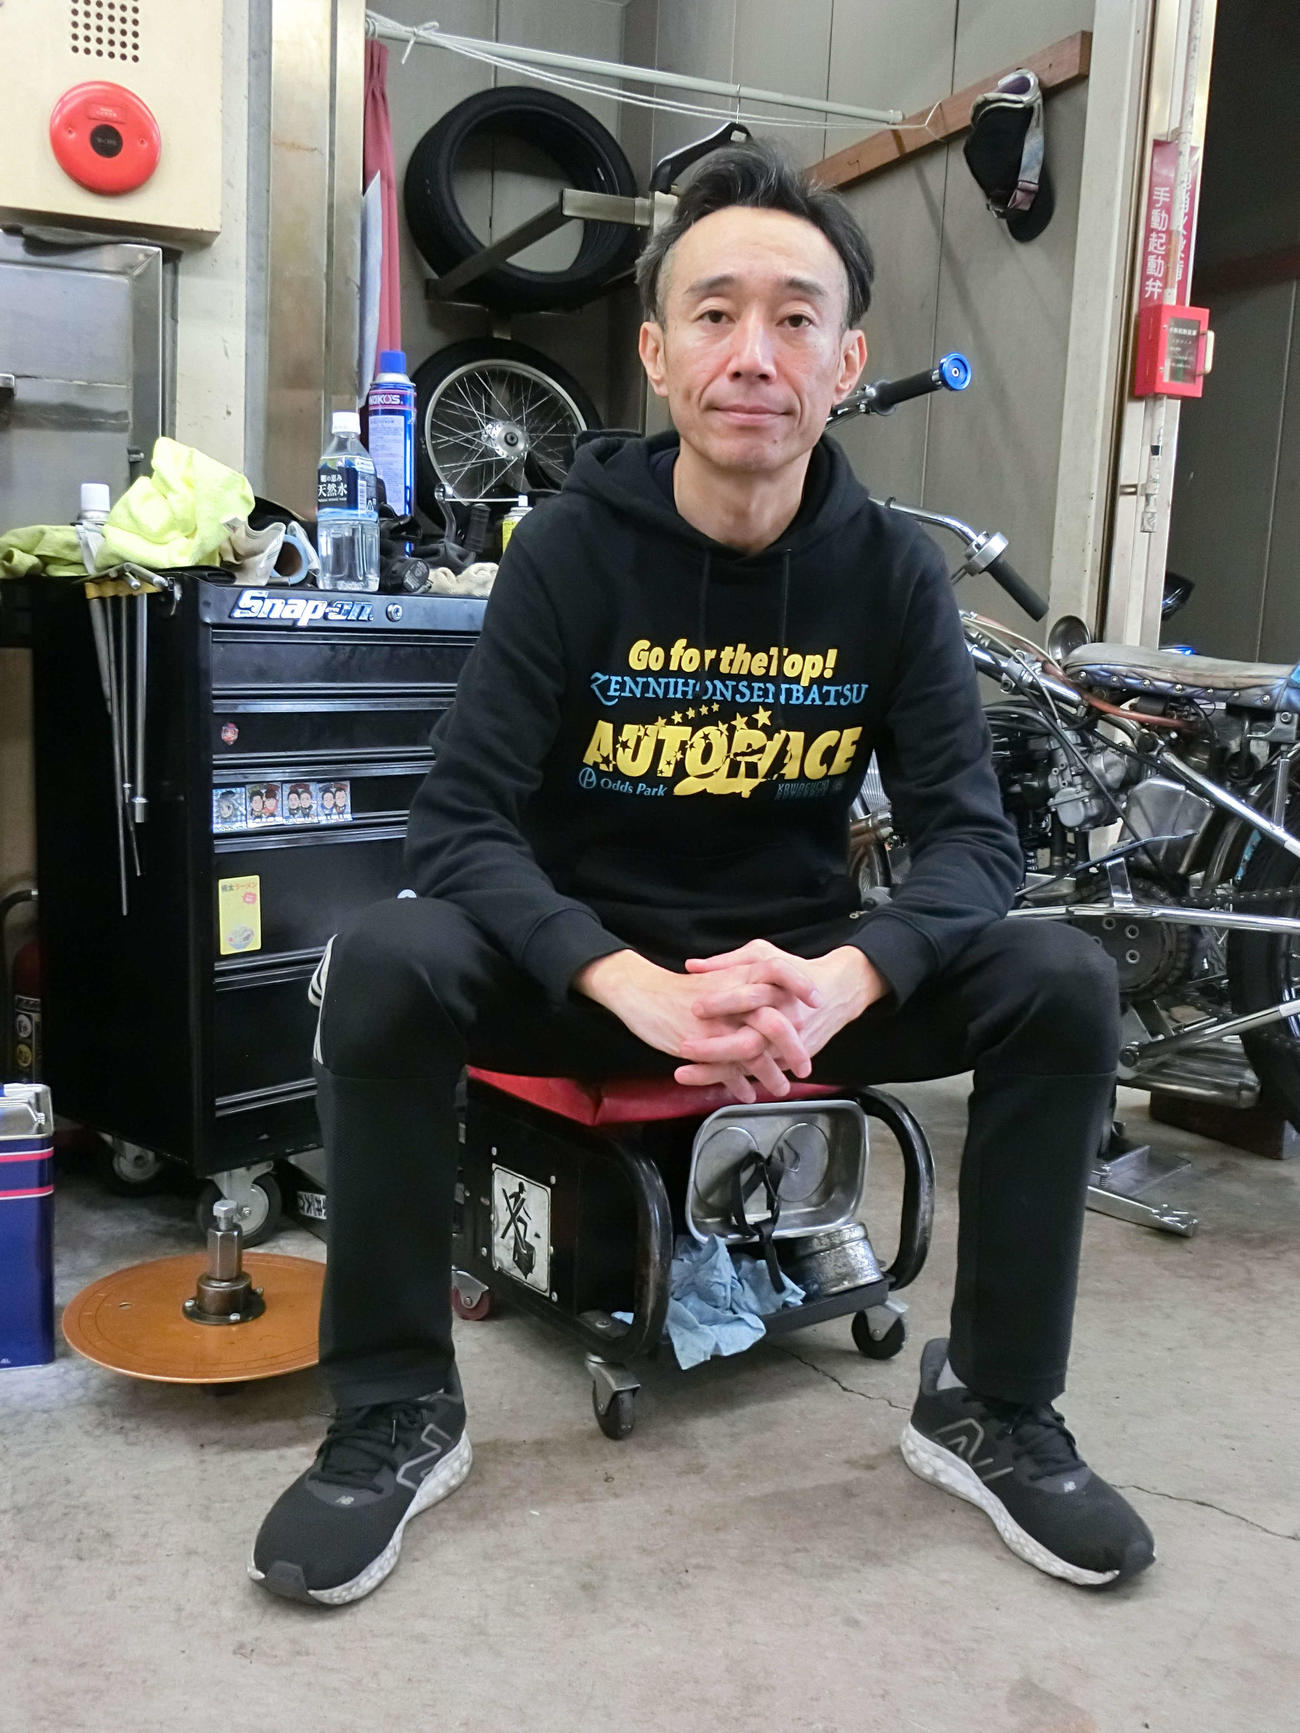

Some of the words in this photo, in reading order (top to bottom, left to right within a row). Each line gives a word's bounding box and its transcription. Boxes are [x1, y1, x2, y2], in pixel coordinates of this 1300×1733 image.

[1144, 186, 1171, 300] 手動起動弁
[318, 482, 348, 497] 天然水
[231, 589, 374, 627] Snap-on
[628, 639, 665, 672] Go
[669, 638, 717, 672] for
[719, 643, 768, 676] the
[583, 719, 864, 782] AUTORACE
[600, 778, 634, 795] Odds
[635, 783, 668, 798] Park
